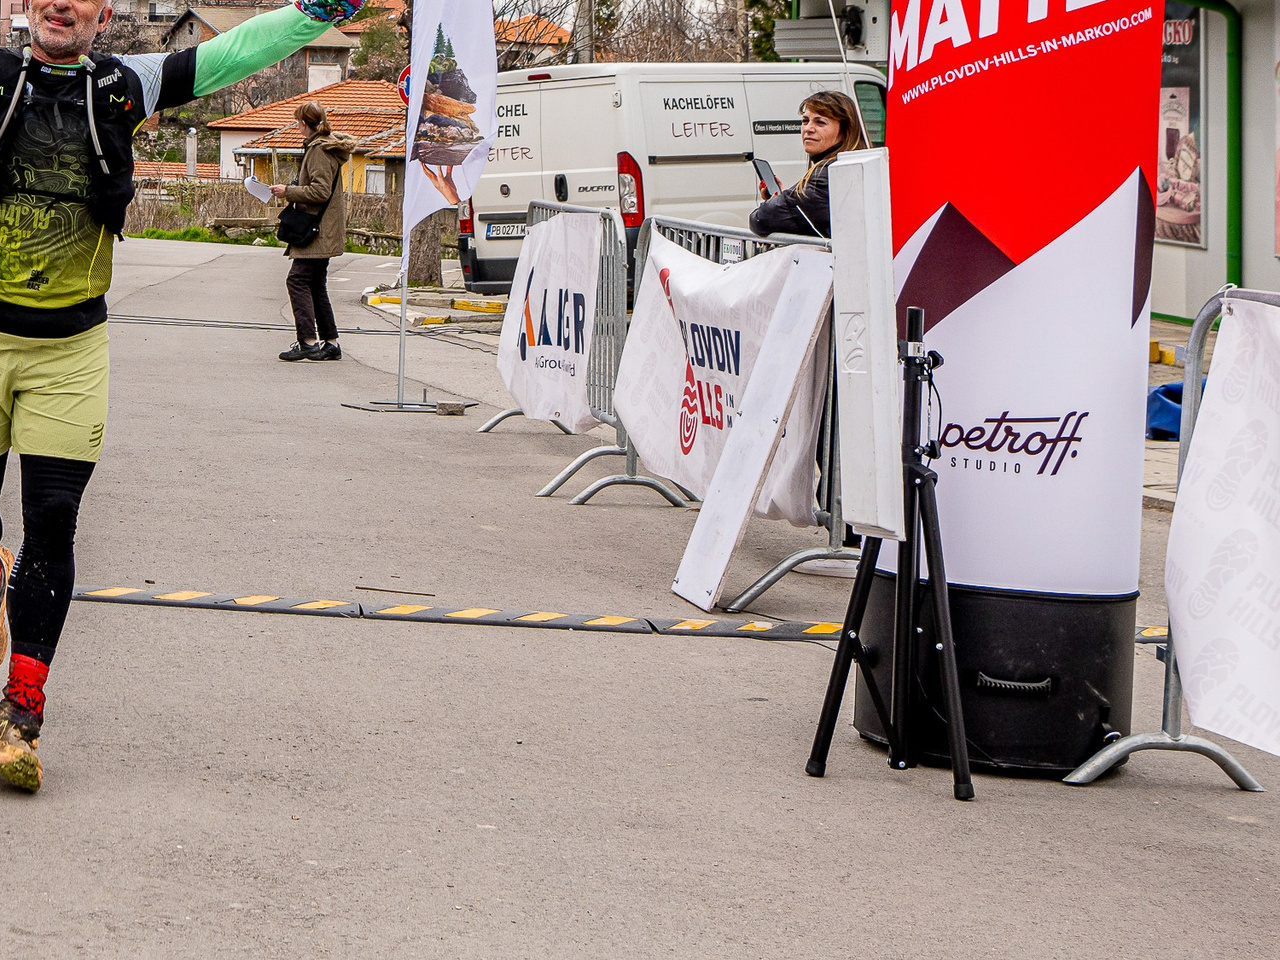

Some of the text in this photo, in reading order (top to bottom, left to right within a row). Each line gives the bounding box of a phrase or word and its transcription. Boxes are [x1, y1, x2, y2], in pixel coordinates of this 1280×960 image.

[901, 7, 1153, 104] WWW.PLOVDIV-HILLS-IN-MARKOVO.COM
[663, 95, 735, 110] KACHELÖFEN
[496, 104, 528, 117] CHEL
[497, 125, 520, 137] FEN
[672, 121, 734, 137] LEITER
[488, 147, 533, 161] EITER
[578, 185, 615, 193] DUCATO
[491, 225, 501, 235] PB
[502, 225, 519, 235] 0271
[697, 381, 723, 430] LLS
[951, 457, 1021, 474] STUDIO
